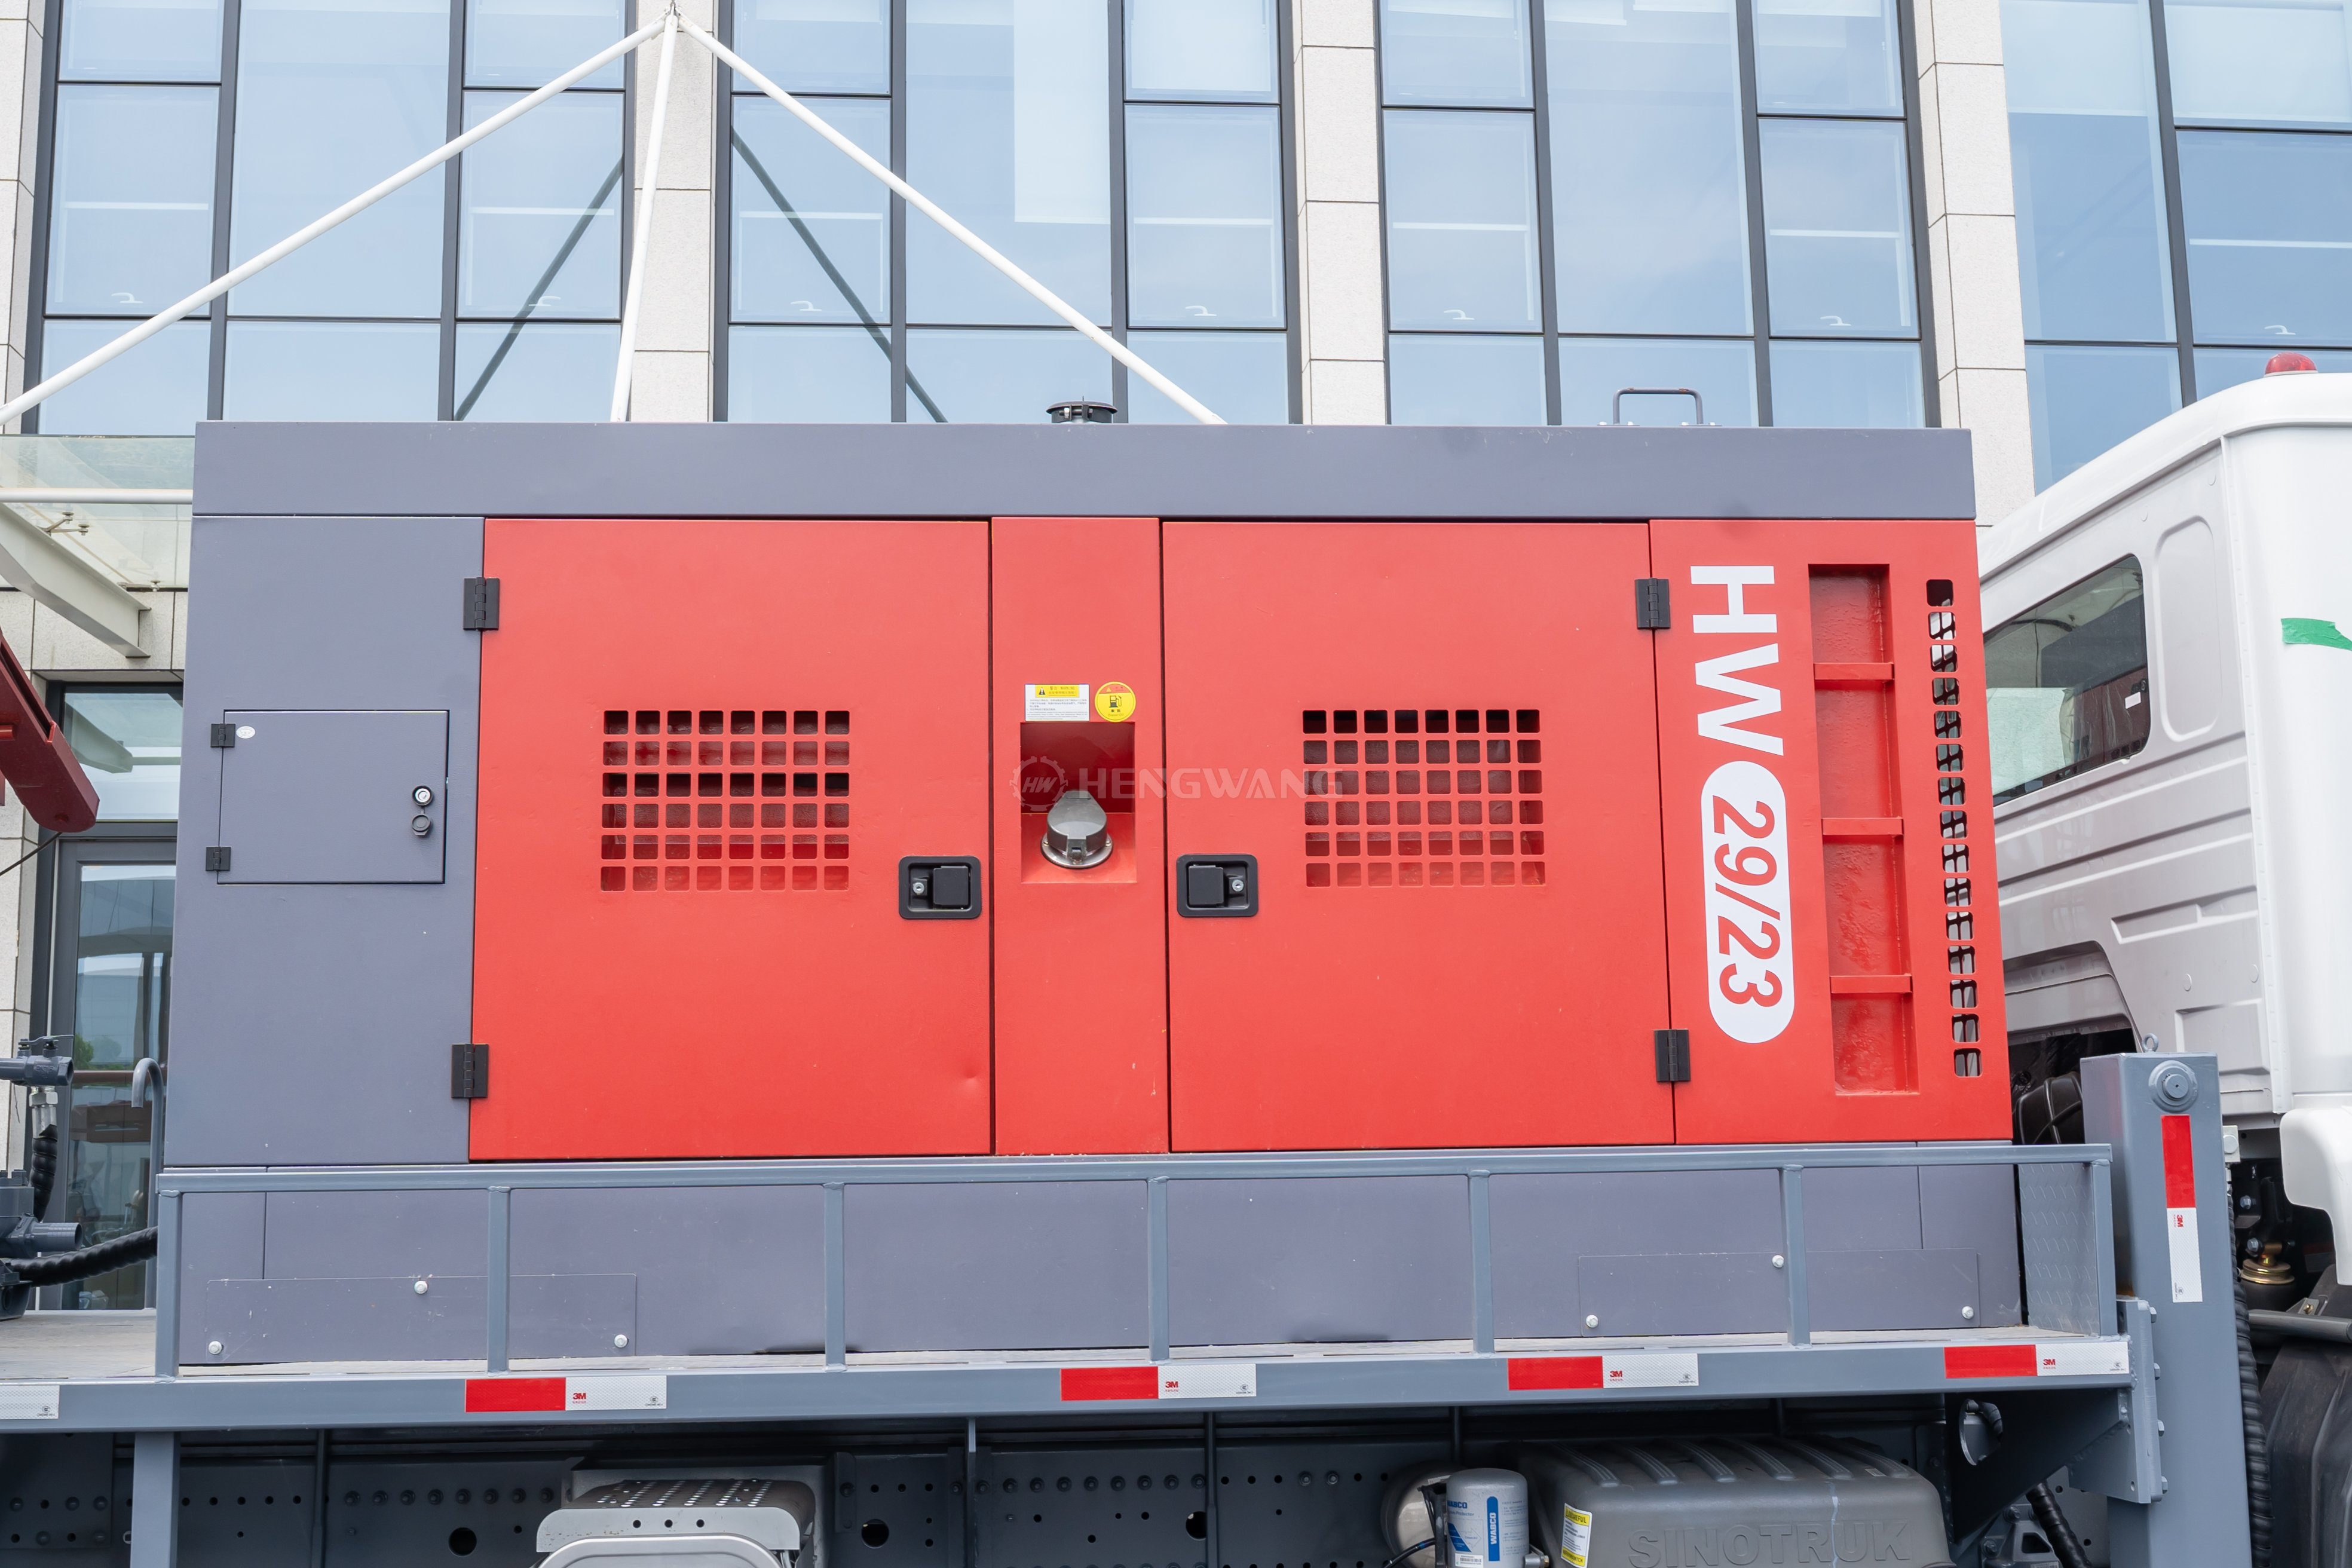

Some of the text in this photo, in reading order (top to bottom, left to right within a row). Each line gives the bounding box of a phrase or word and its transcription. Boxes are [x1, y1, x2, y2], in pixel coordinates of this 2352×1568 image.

[1690, 566, 1784, 1007] HW 29/23
[2177, 1214, 2183, 1227] 3M
[1628, 1519, 1911, 1568] SINOTRUK
